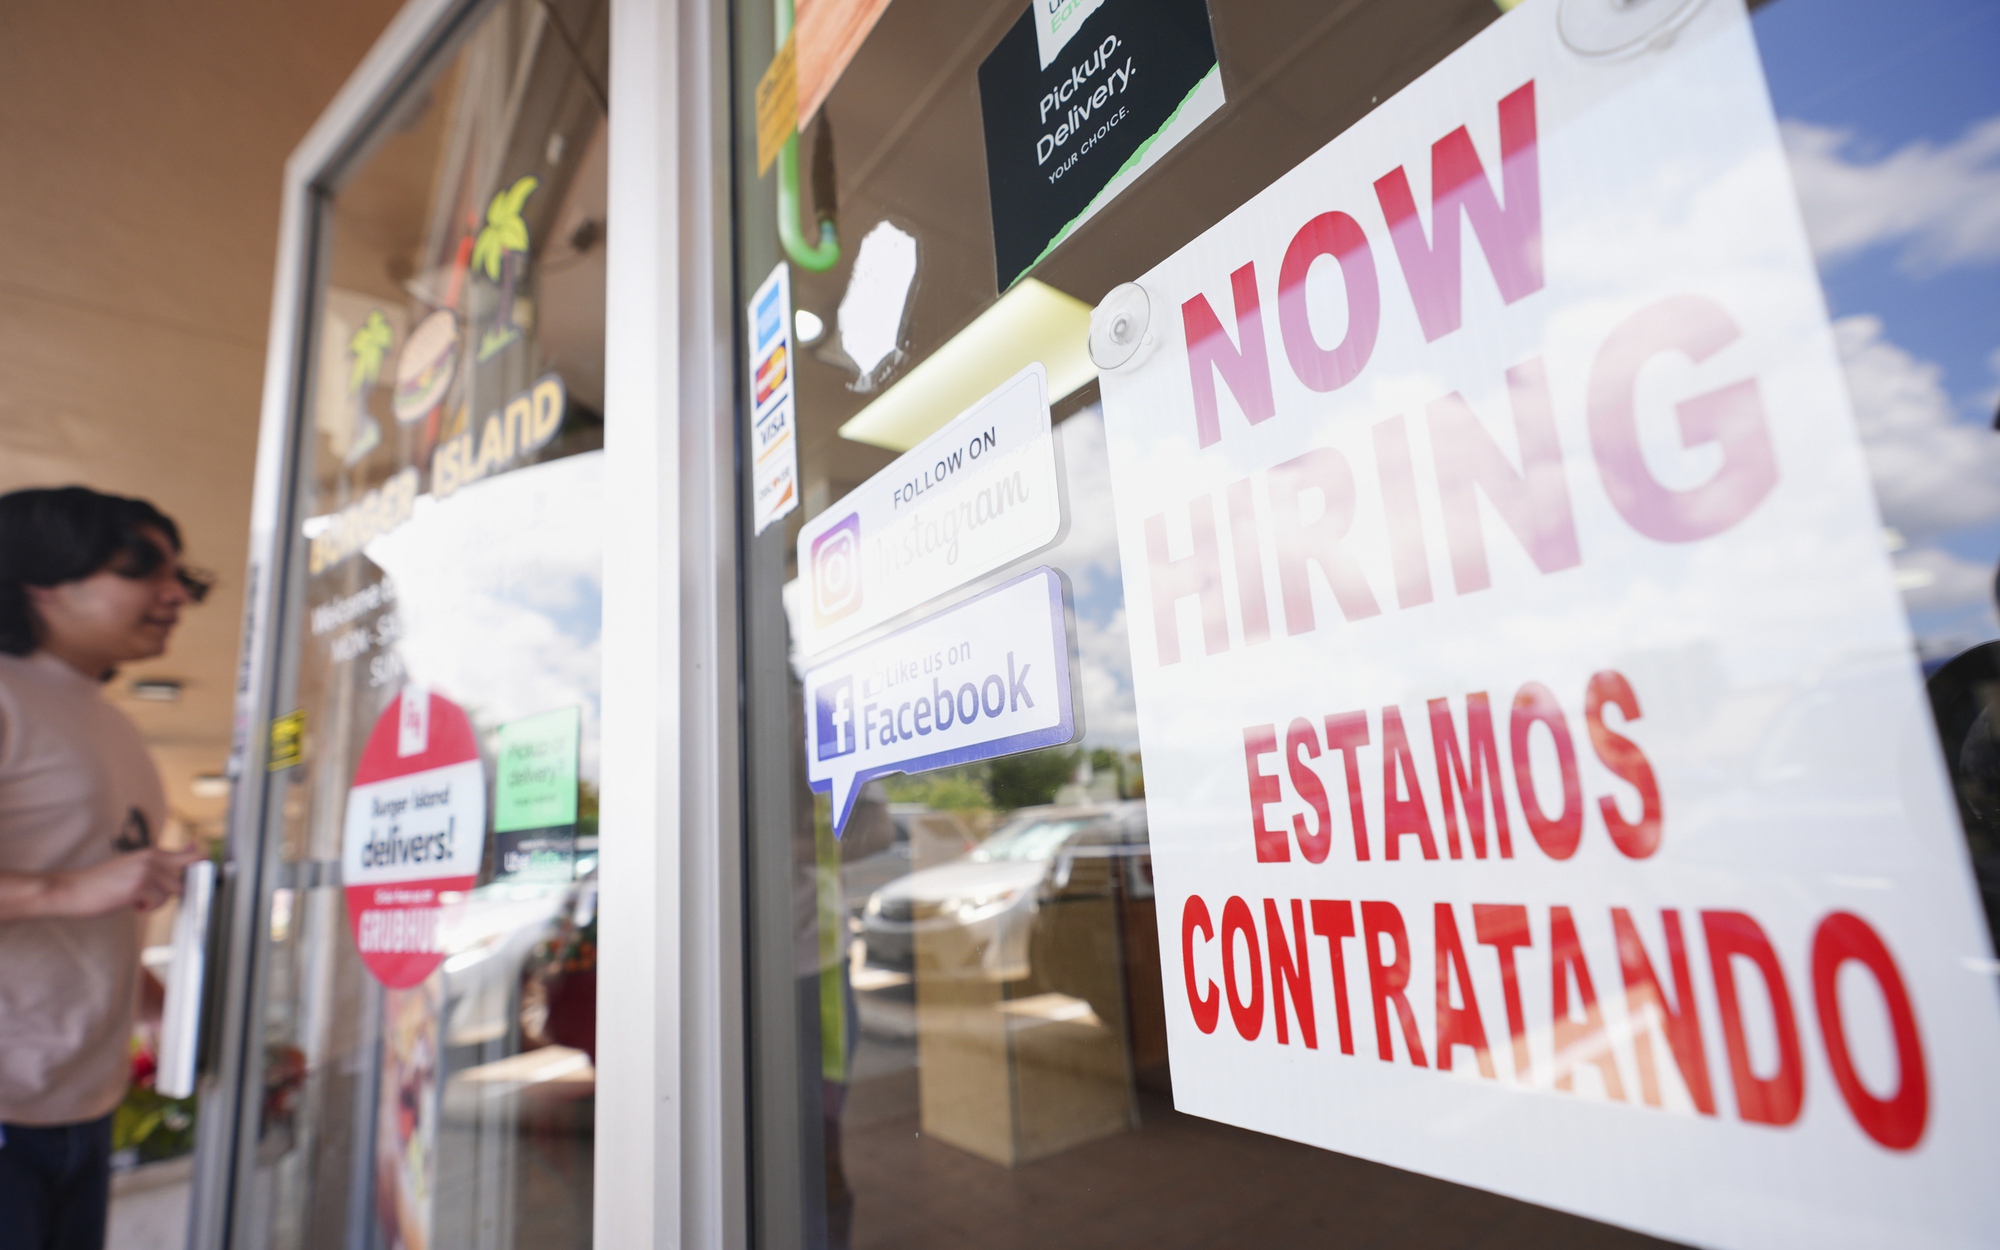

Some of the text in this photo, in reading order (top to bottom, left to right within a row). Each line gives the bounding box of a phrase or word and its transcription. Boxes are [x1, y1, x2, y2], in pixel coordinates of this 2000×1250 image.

[1051, 0, 1083, 34] Eat
[1036, 56, 1136, 166] Delivery.
[1039, 35, 1122, 125] Pickup.
[1048, 106, 1130, 184] YOUR CHOICE.
[1181, 78, 1545, 450] NOW
[431, 376, 568, 502] ISLAND
[760, 411, 786, 446] VISA
[894, 426, 997, 510] FOLLOW ON
[873, 470, 1030, 584] Instagram
[1143, 293, 1781, 667] HIRING
[863, 651, 1036, 750] Facebook
[887, 640, 971, 689] Like us on
[1242, 669, 1664, 864] ESTAMOS
[360, 815, 456, 869] delivers!
[1181, 894, 1931, 1155] CONTRATANDO
